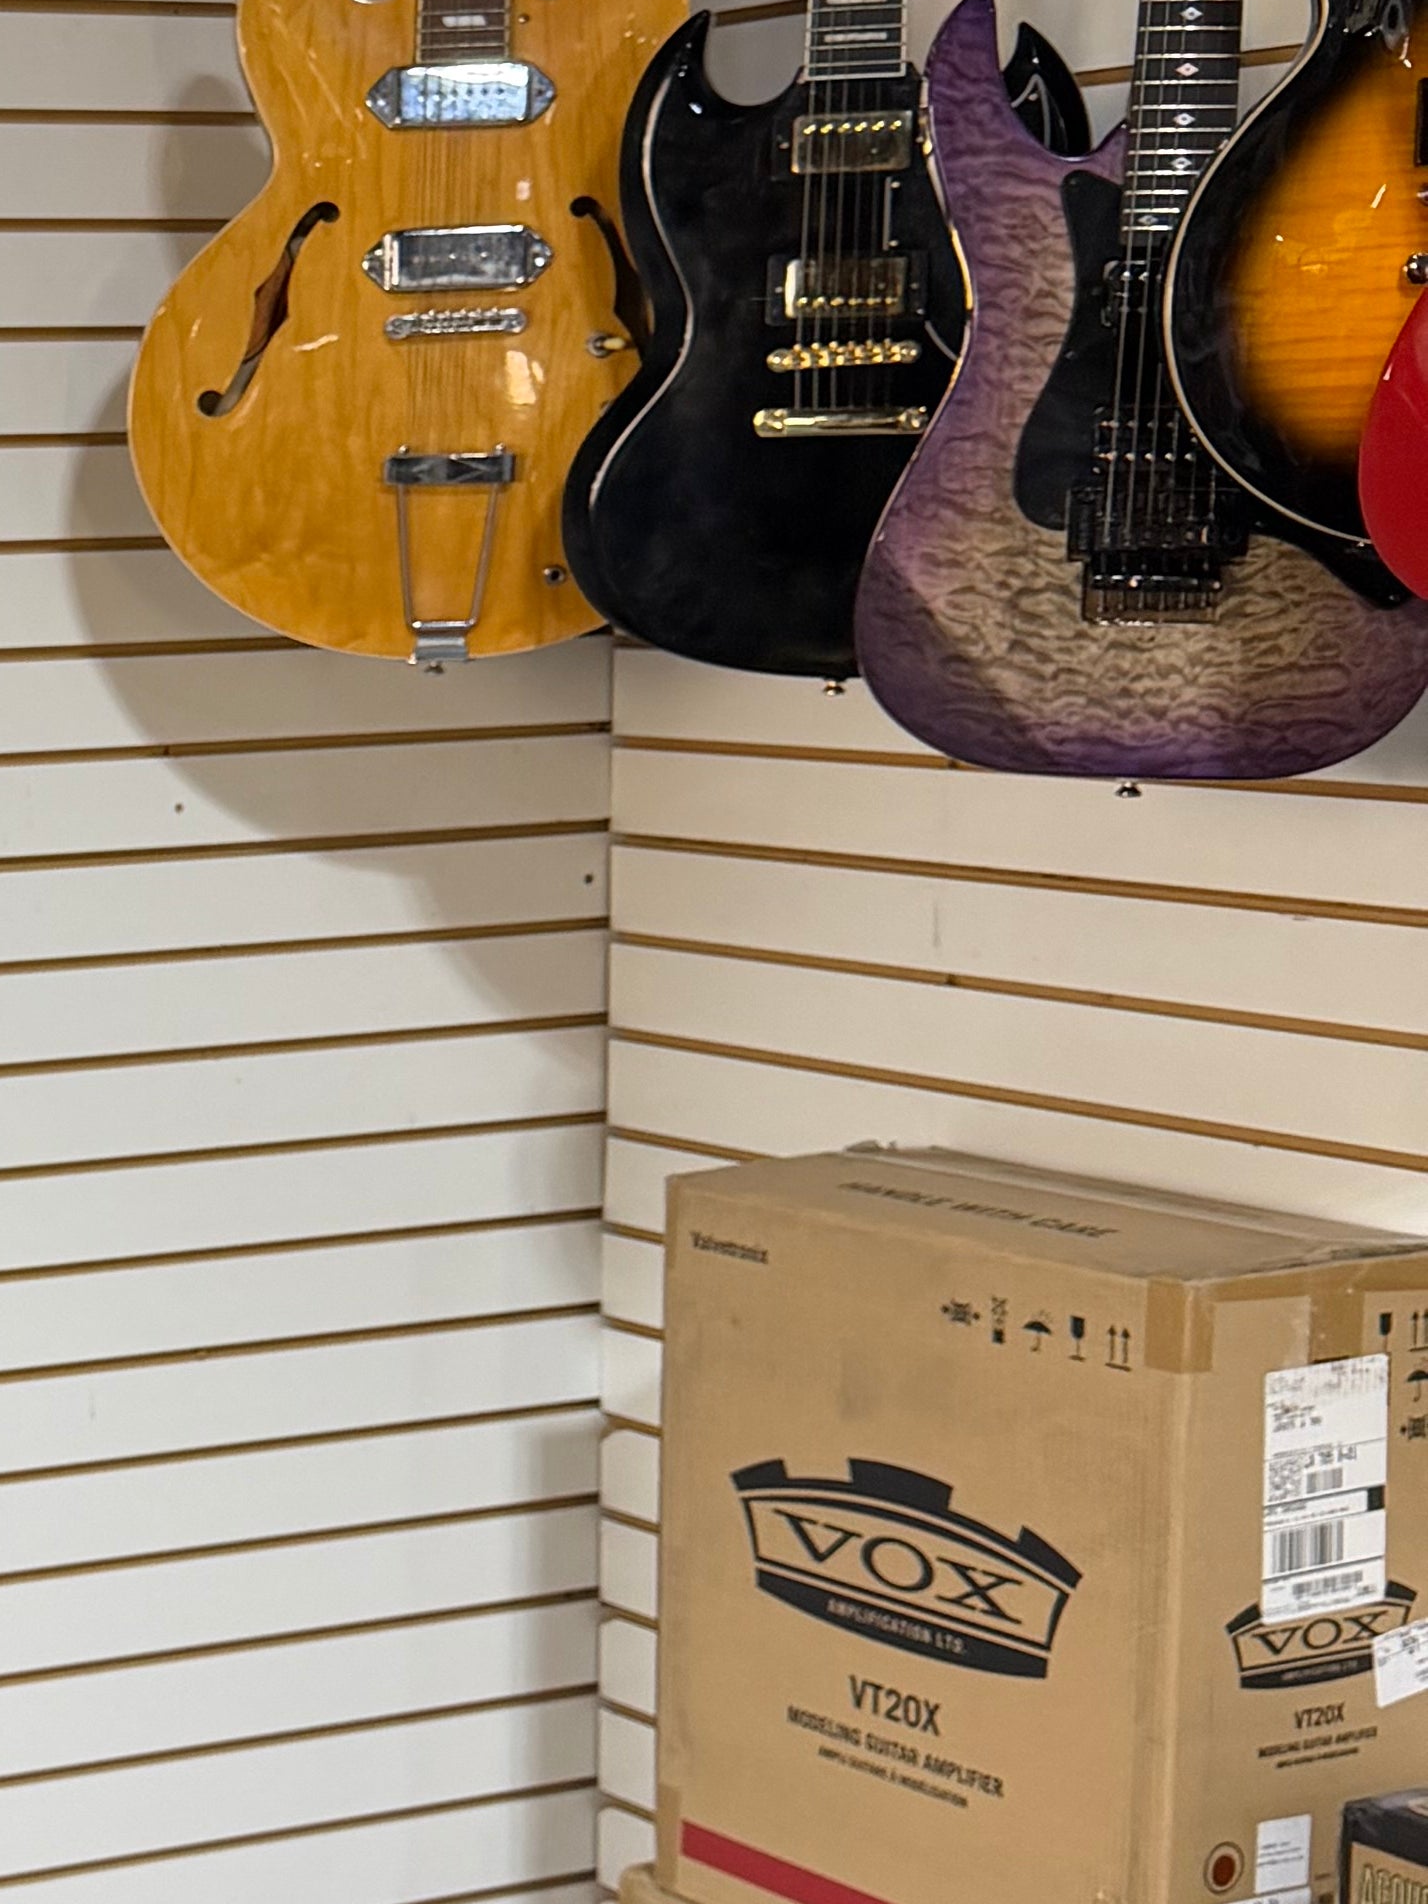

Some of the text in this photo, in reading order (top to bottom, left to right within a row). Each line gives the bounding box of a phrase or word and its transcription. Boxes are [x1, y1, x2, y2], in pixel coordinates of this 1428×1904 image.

[773, 1508, 1024, 1625] VOX
[1253, 1610, 1388, 1656] VOX
[848, 1674, 942, 1737] VT20X
[1294, 1701, 1345, 1730] VT20X
[921, 1753, 1005, 1798] AMPLIFIER
